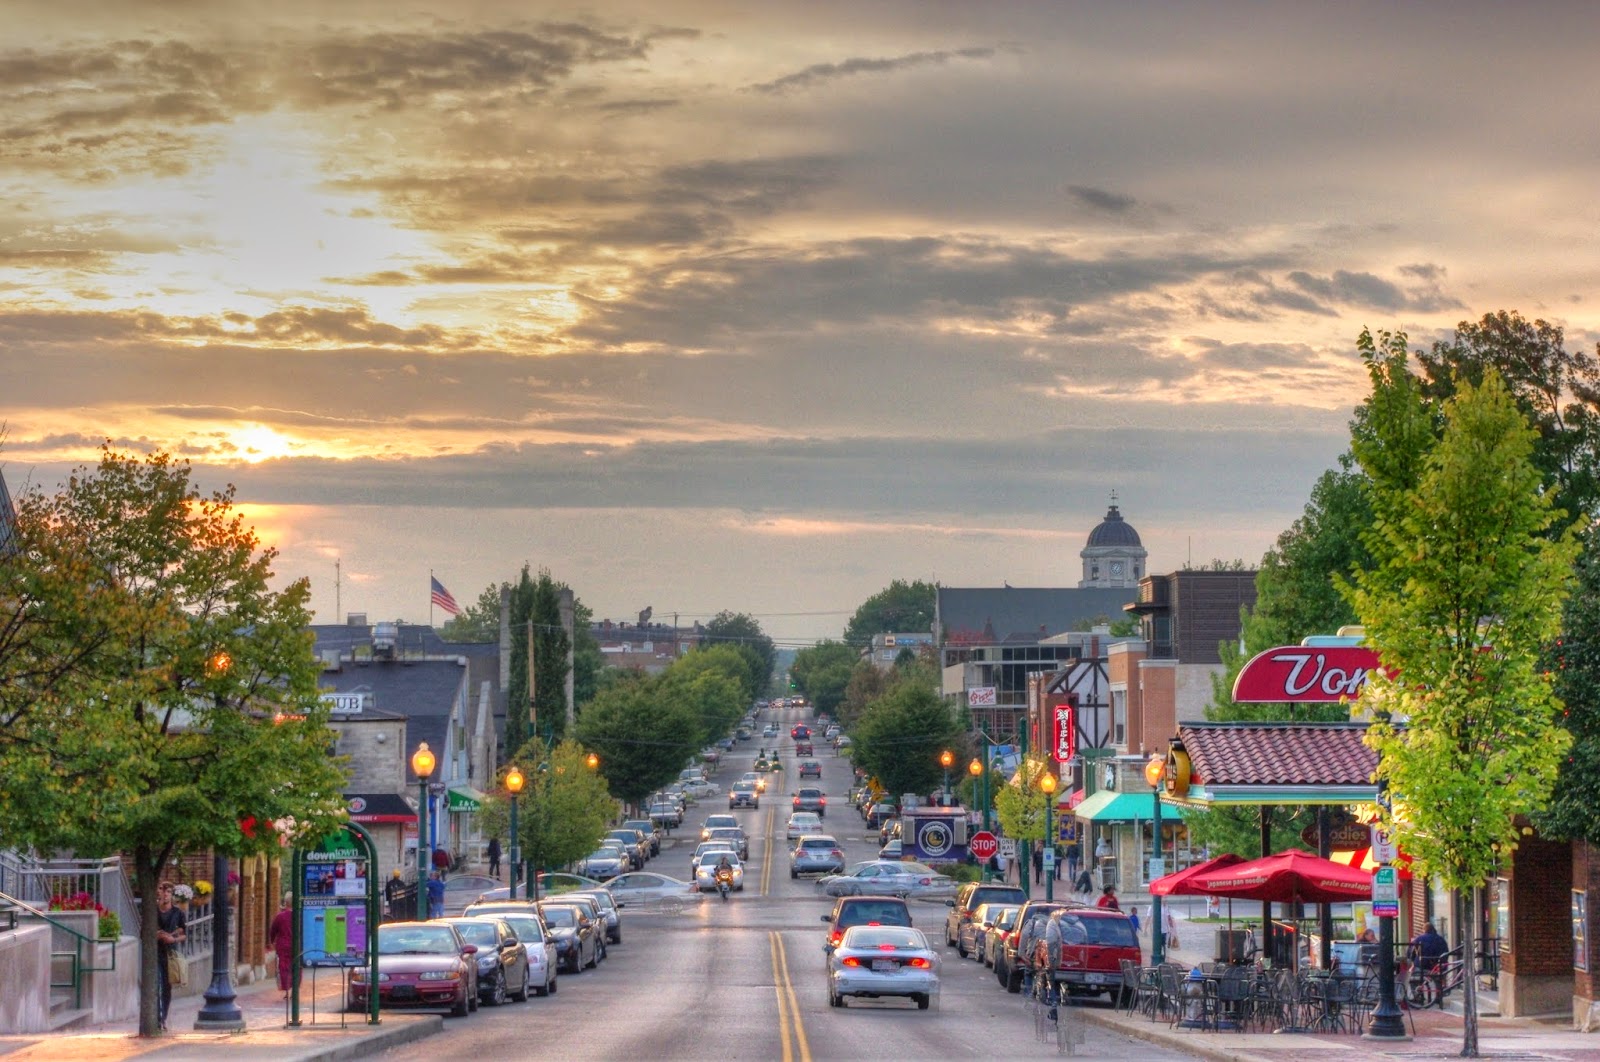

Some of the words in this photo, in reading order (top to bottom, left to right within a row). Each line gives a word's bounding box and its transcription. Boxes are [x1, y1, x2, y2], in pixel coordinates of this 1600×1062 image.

[325, 697, 359, 709] UB
[970, 689, 994, 705] Pizza
[1311, 825, 1367, 841] nodles
[972, 841, 996, 850] STOP
[306, 848, 359, 860] downtown
[1207, 880, 1232, 889] japanese
[1233, 878, 1244, 887] pan
[1245, 876, 1268, 885] noodles
[1320, 879, 1340, 887] pesto
[303, 899, 338, 907] bloomington
